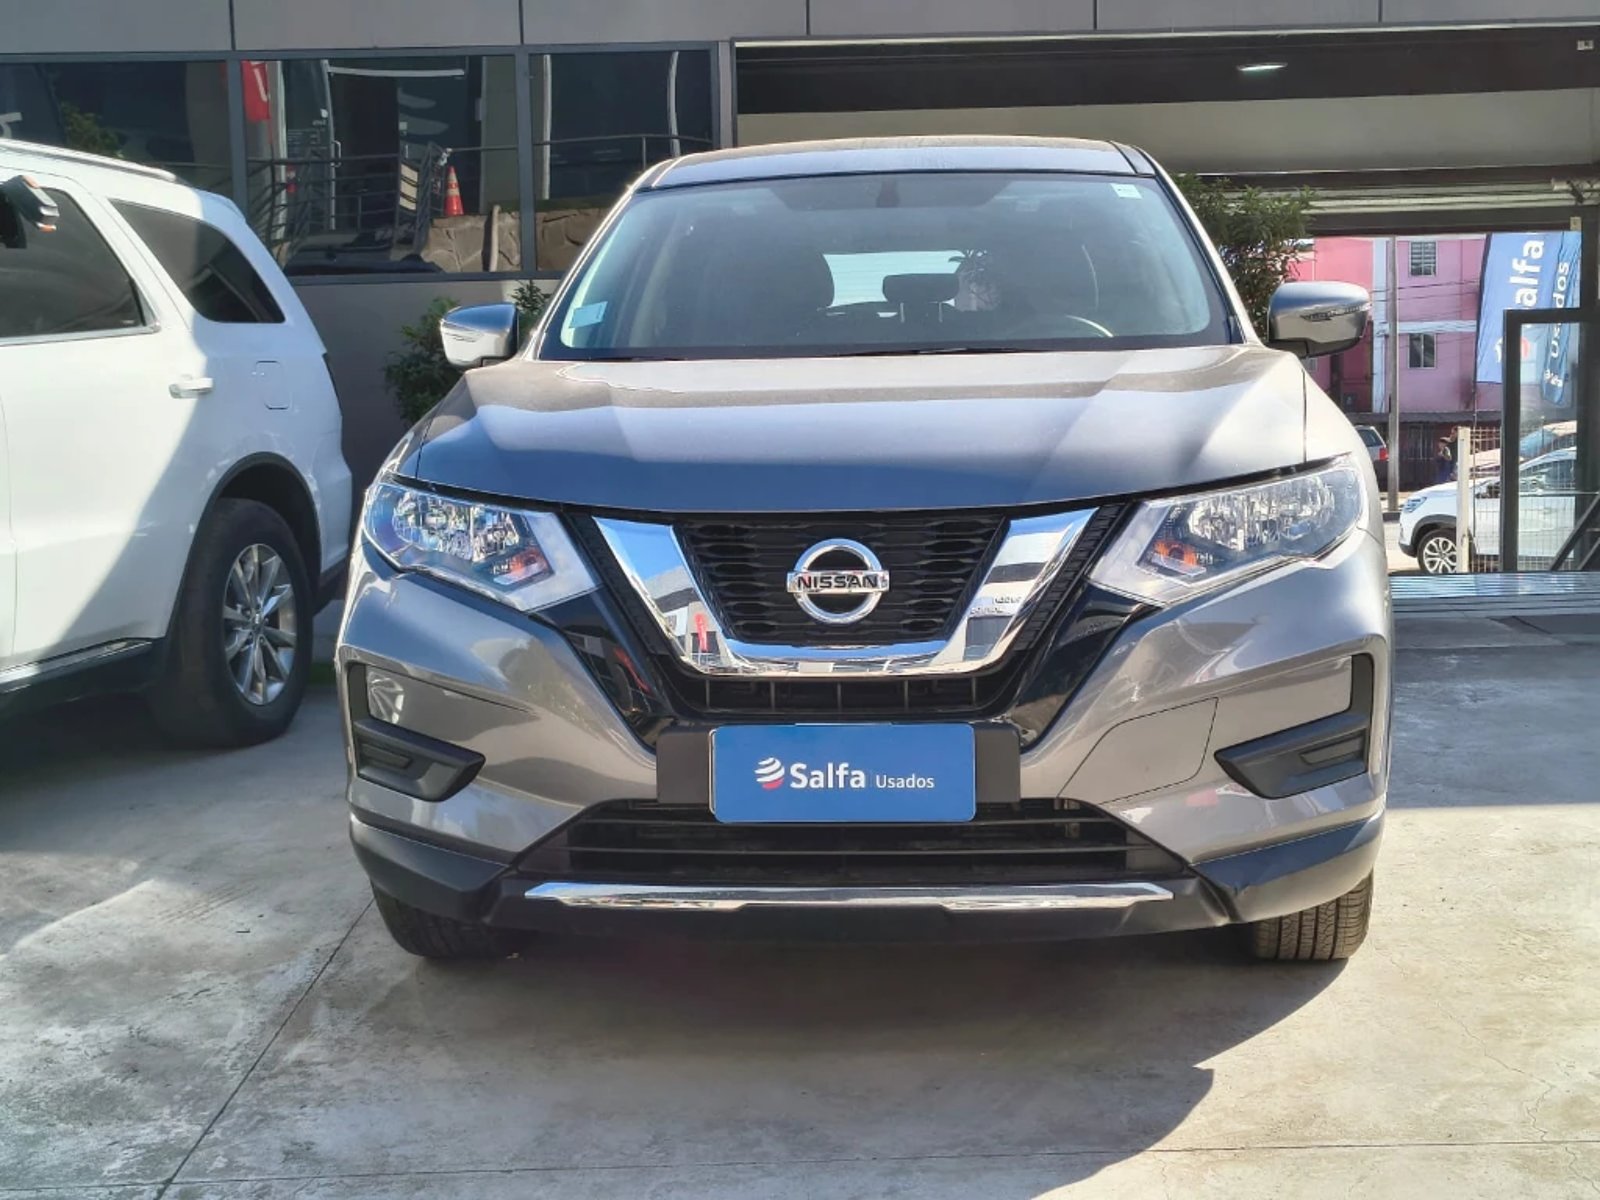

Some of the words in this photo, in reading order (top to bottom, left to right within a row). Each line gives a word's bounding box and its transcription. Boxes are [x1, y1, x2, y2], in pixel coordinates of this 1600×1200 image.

[1509, 240, 1545, 316] alfa
[1550, 262, 1569, 358] Usdos
[797, 575, 878, 589] NISSAN
[790, 763, 866, 789] Salfa
[876, 774, 935, 789] Usados
